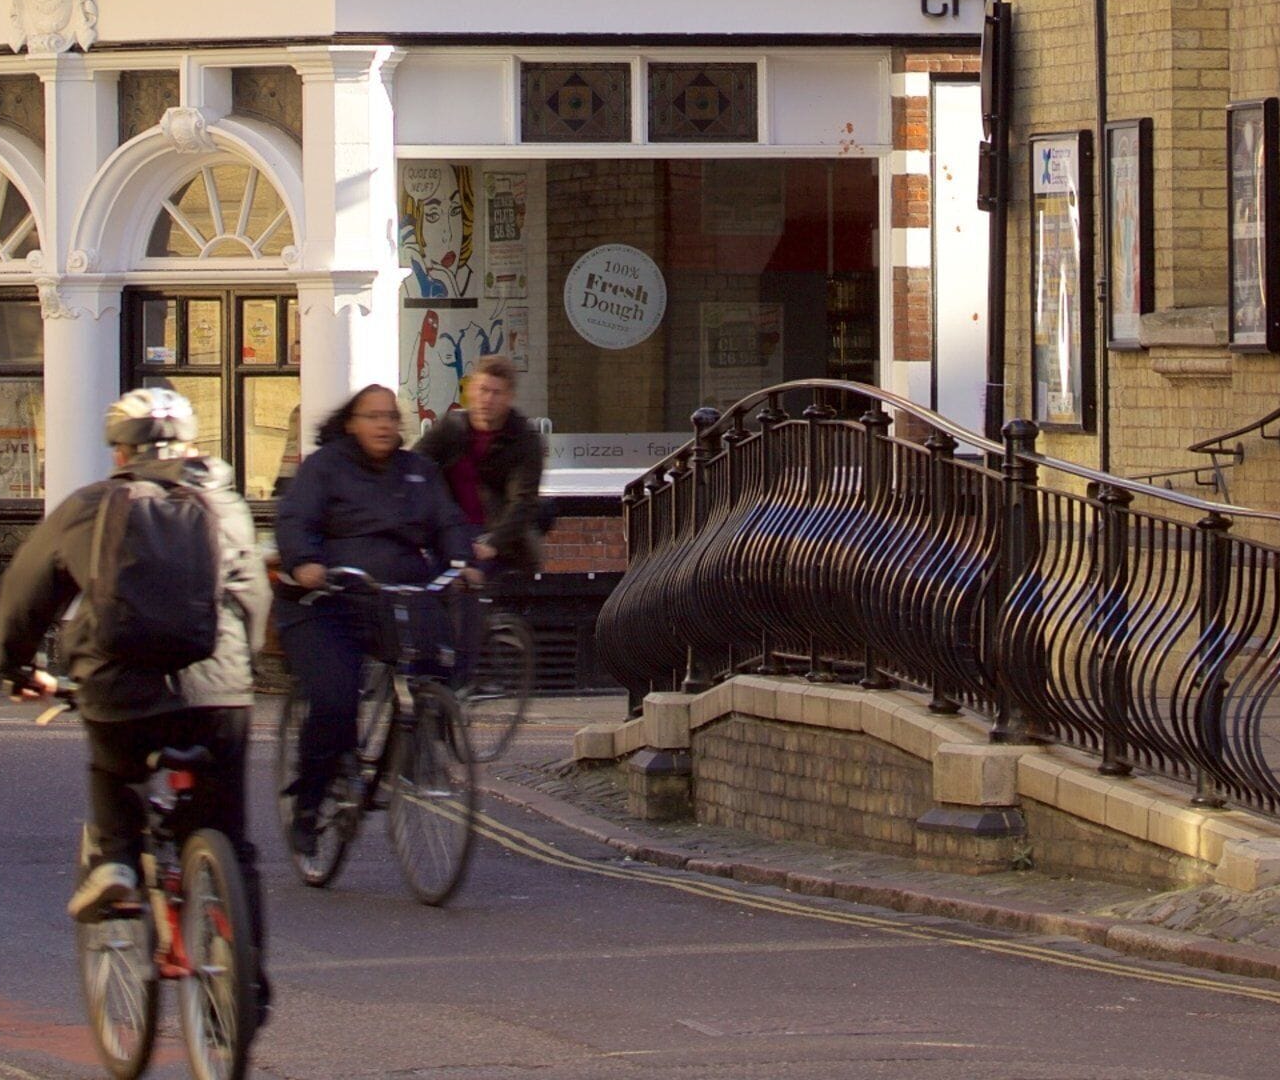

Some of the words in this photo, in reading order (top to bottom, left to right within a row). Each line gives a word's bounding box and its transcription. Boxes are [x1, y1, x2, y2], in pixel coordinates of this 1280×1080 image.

[604, 260, 640, 280] 100%
[586, 272, 648, 305] Fresh
[581, 291, 644, 322] Dough
[573, 442, 624, 459] pizza
